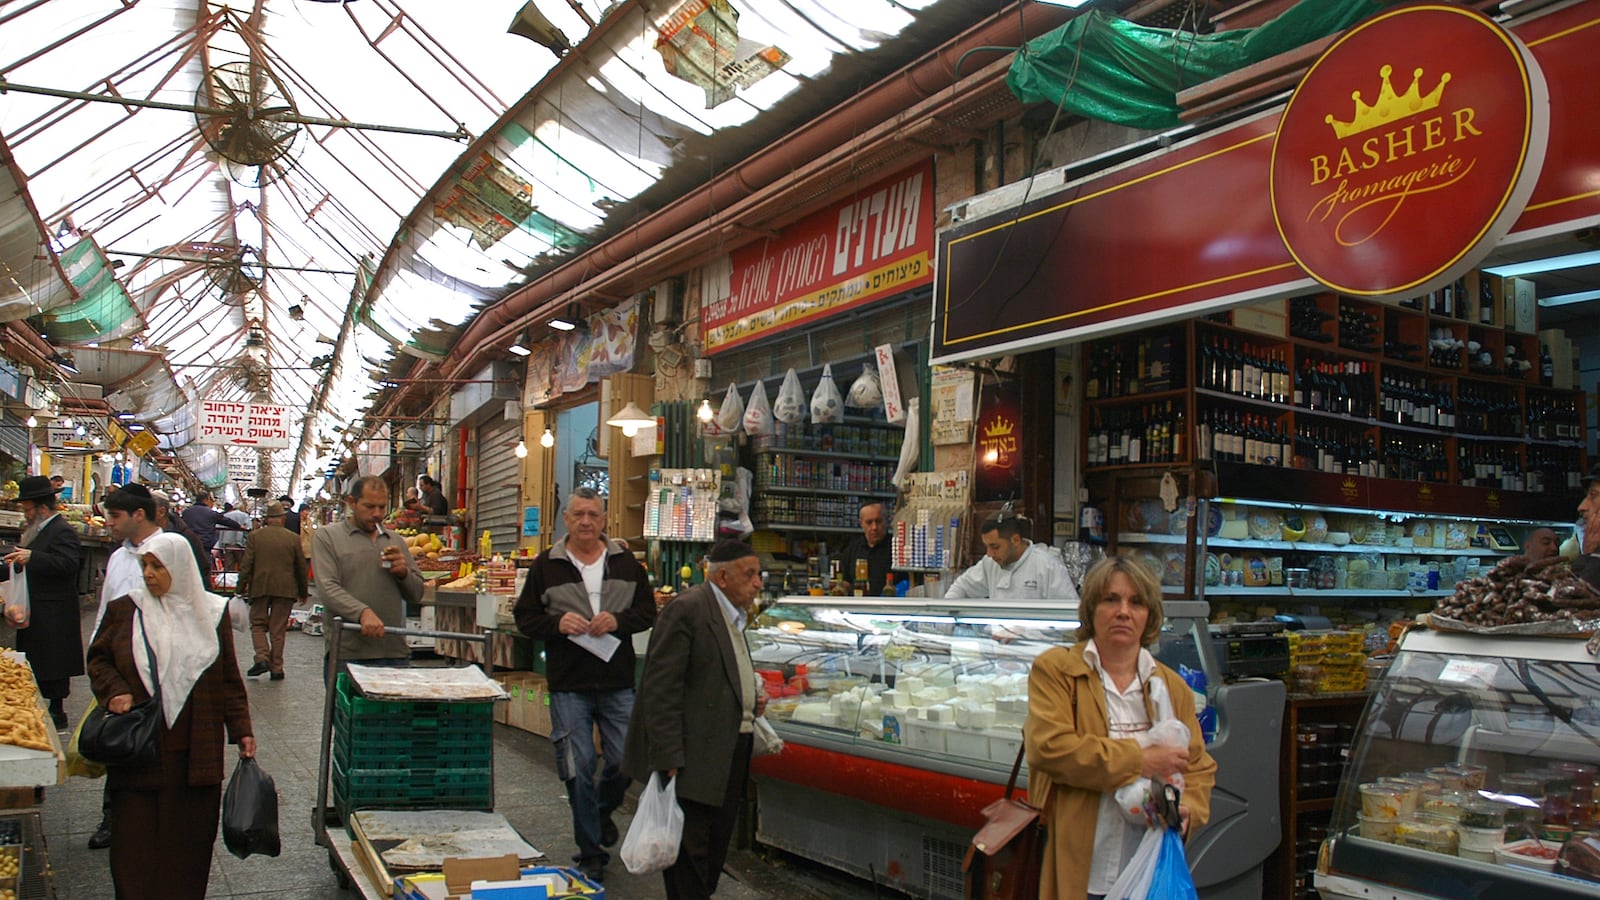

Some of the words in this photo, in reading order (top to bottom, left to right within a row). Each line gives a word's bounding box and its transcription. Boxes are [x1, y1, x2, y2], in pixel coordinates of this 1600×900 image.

[1309, 106, 1482, 185] BASHER
[1306, 154, 1474, 228] fromagerie
[832, 171, 924, 277] מעדנים
[873, 259, 921, 289] פיצוחים
[203, 402, 245, 413] לרחוב
[250, 405, 285, 415] יציאה
[207, 414, 243, 424] יהודה
[248, 416, 280, 426] מחנה
[201, 425, 243, 436] העירקי
[248, 427, 286, 438] ולשוק
[52, 433, 75, 443] יצחק
[980, 436, 1017, 456] באשר
